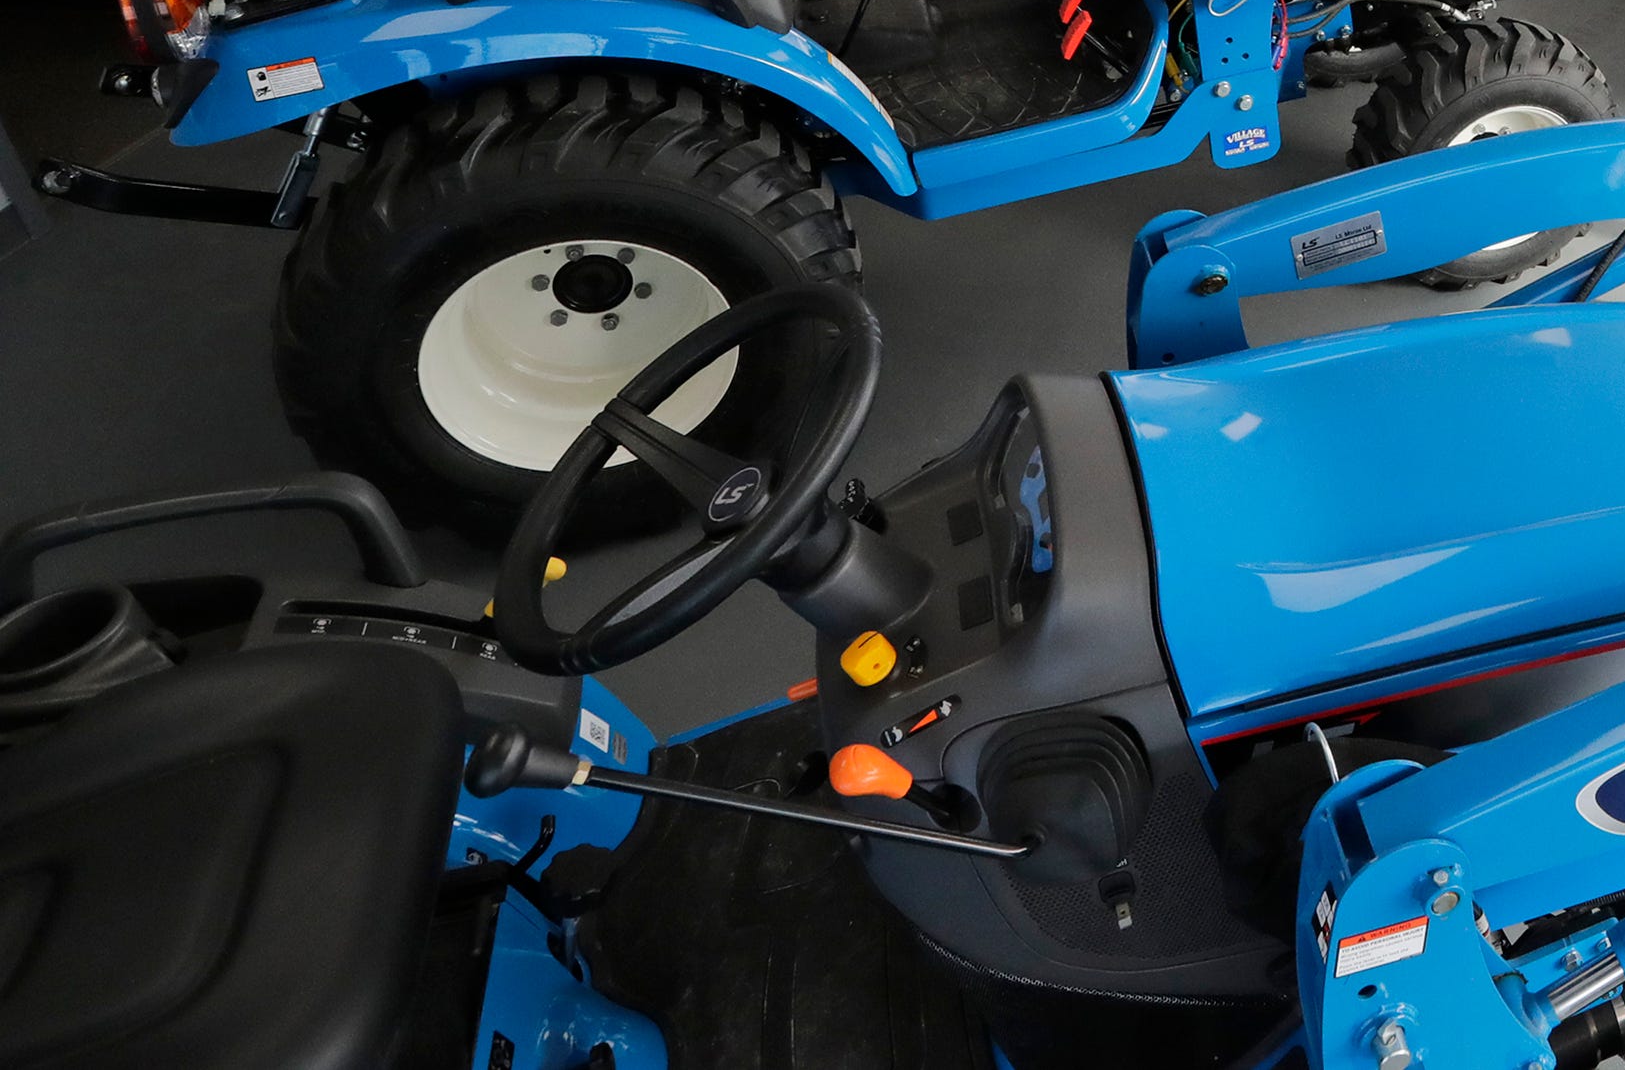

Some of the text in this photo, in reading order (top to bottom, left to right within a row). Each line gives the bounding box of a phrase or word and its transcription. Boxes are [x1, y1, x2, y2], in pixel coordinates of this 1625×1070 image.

[1226, 128, 1266, 143] VILLAGE
[1302, 238, 1319, 250] LS
[714, 484, 748, 505] LS
[1370, 923, 1411, 938] WARNING
